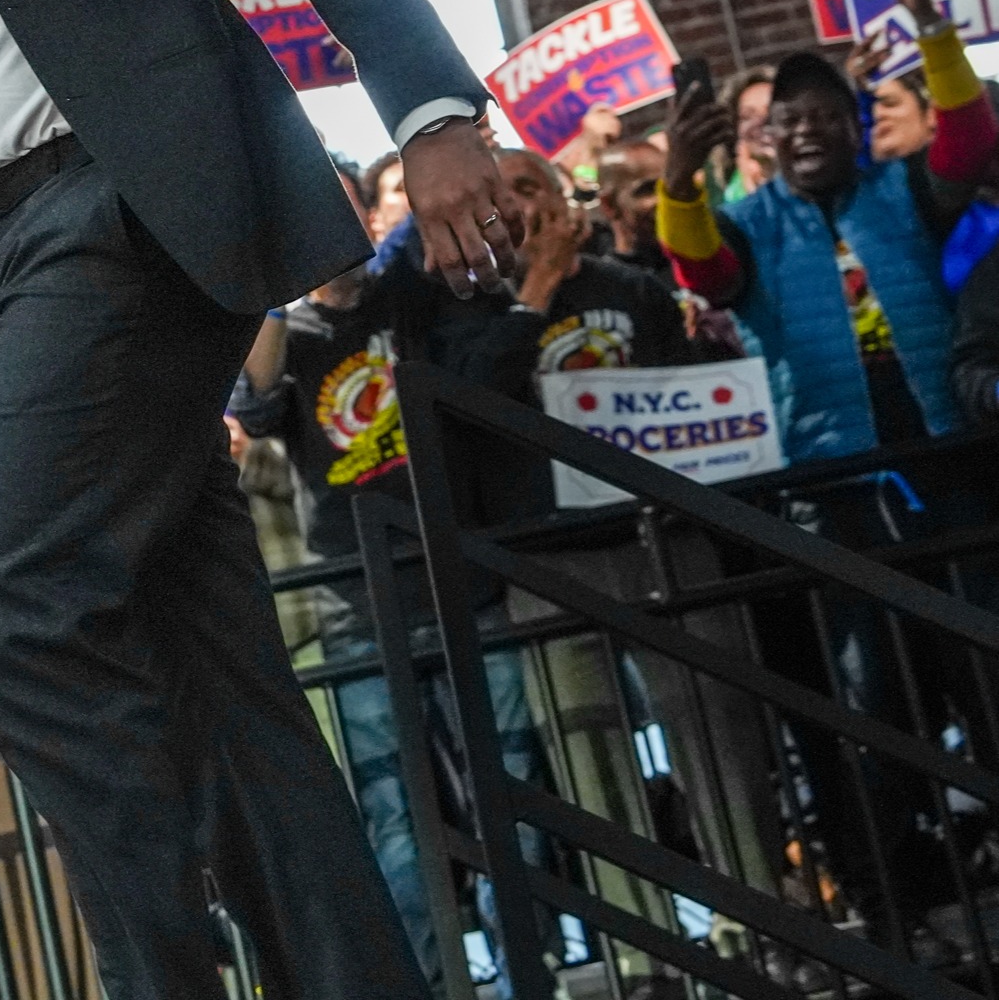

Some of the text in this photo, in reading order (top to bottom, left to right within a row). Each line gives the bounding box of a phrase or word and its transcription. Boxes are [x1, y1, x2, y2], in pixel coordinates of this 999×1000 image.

[495, 0, 640, 103] TACKLE
[527, 52, 675, 151] WASTE
[586, 411, 770, 452] ROCERIES
[612, 391, 702, 414] N.Y.C.
